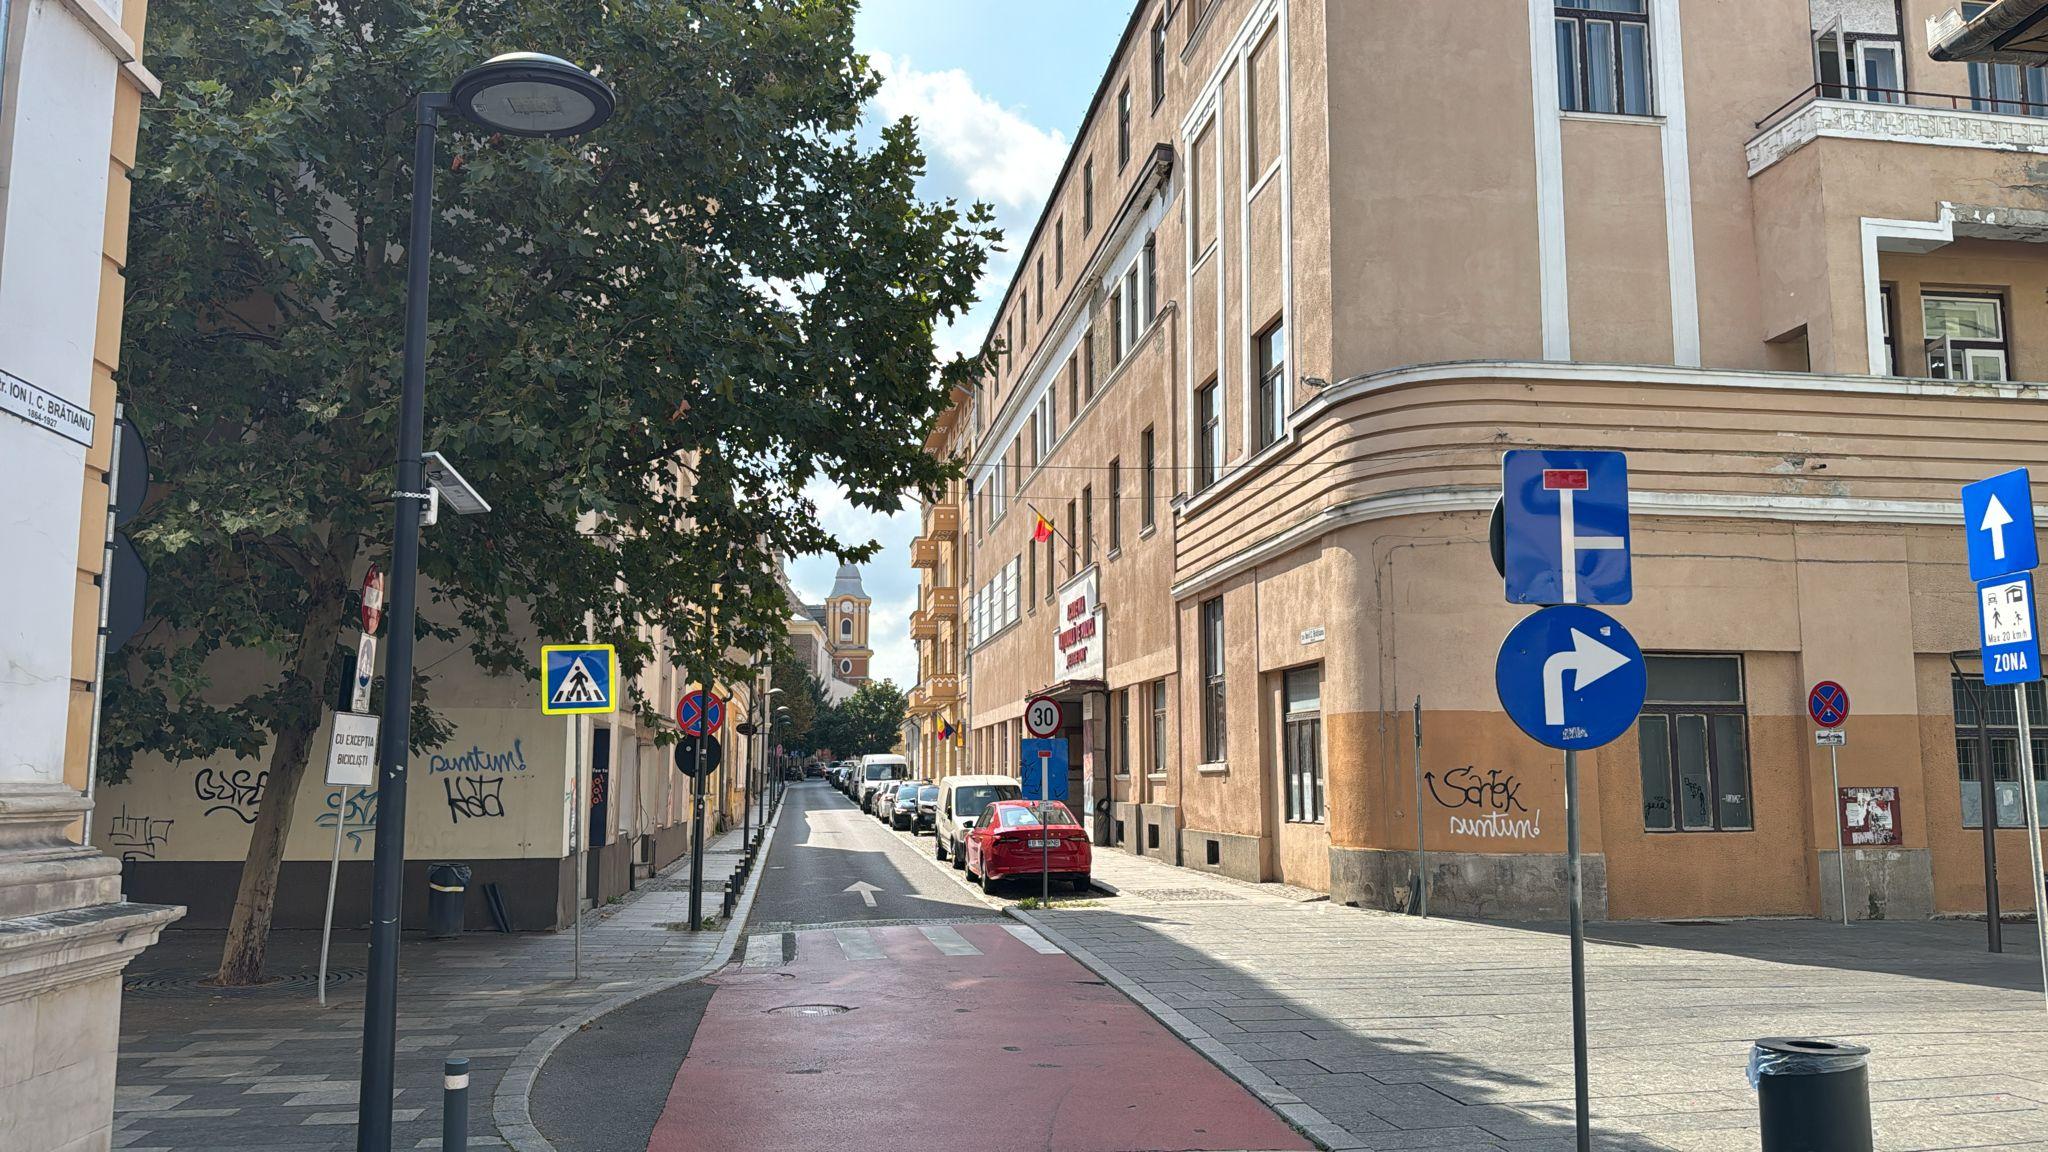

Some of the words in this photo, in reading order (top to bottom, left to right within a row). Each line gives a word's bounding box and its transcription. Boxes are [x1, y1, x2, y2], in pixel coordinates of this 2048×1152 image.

[10, 382, 27, 402] ION
[29, 391, 34, 406] I.
[36, 395, 45, 411] C.
[48, 400, 92, 432] BRĂTIANU
[2002, 631, 2011, 641] 20
[1993, 651, 2028, 673] ZONA
[1034, 707, 1054, 727] 30
[335, 733, 344, 745] CU
